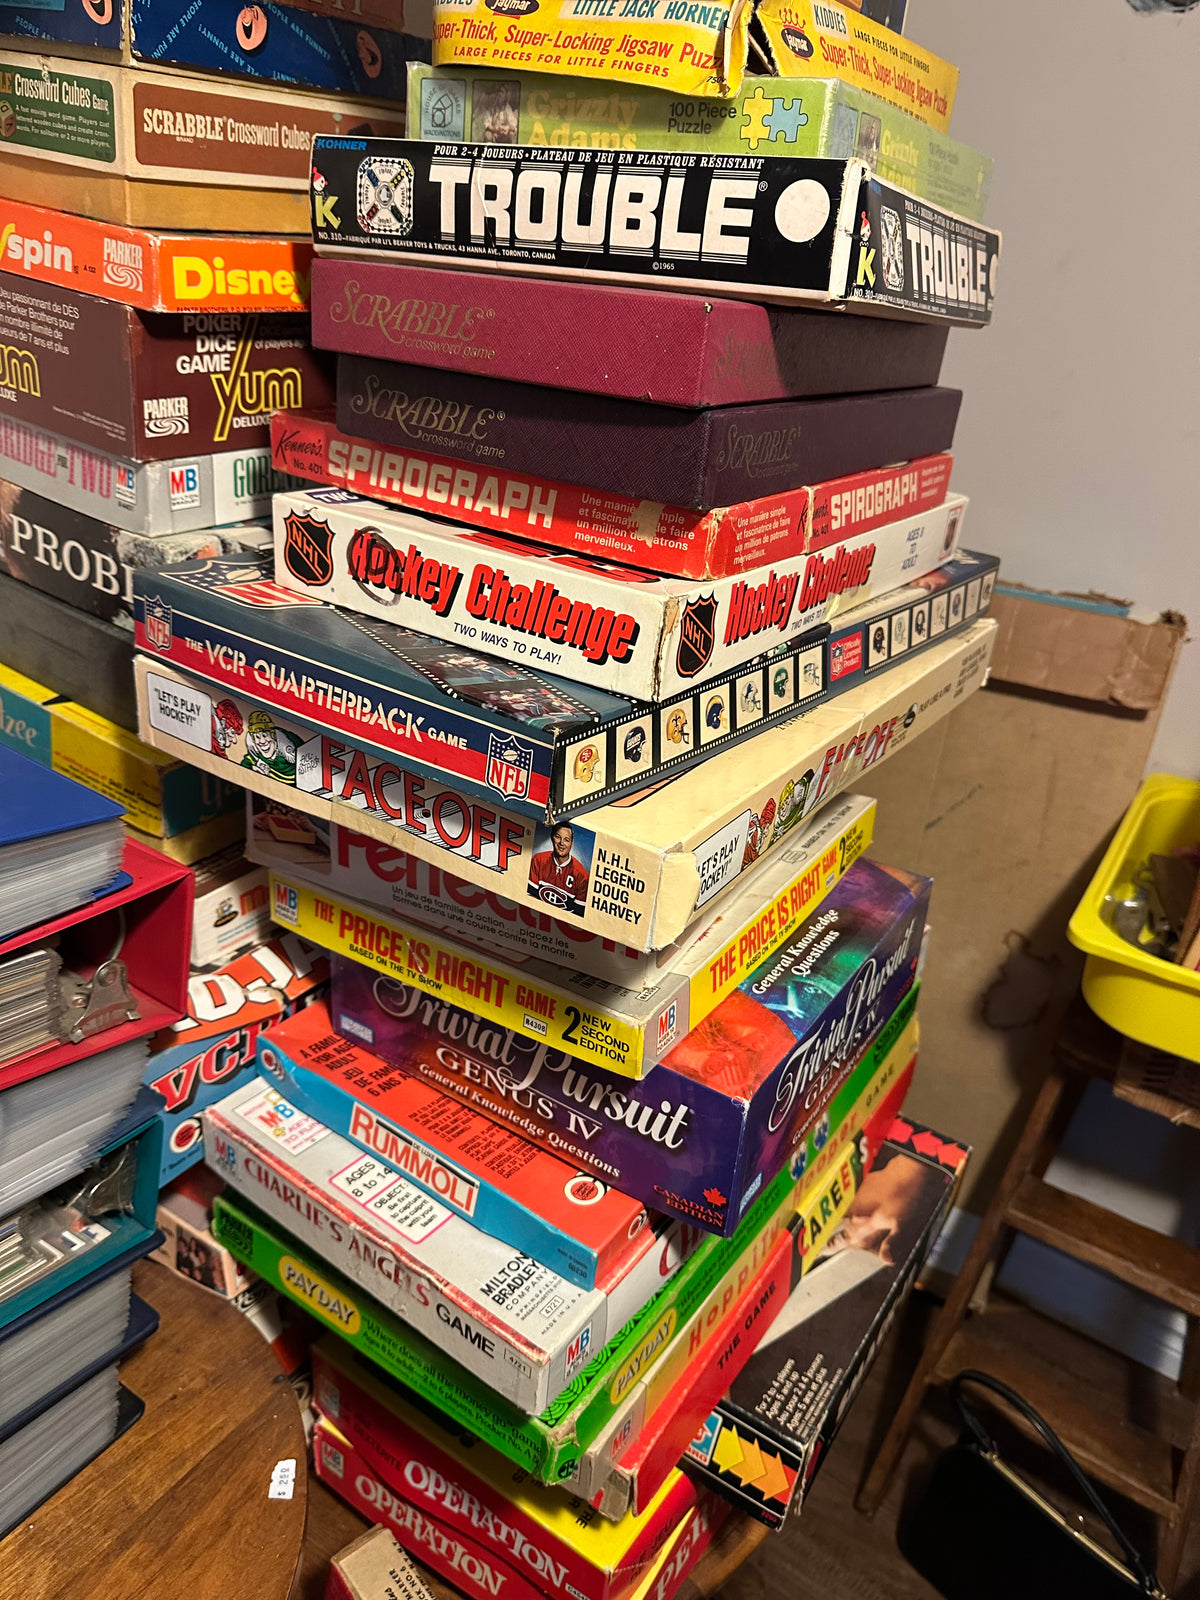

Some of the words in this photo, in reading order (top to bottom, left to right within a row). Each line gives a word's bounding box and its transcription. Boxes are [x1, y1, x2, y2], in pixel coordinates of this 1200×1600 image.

[620, 0, 657, 18] JACK
[666, 1, 729, 31] HORNER
[814, 5, 848, 35] KIDDIES
[504, 25, 614, 57] Super-Locking
[616, 34, 674, 59] Jigsaw
[453, 46, 487, 58] LARGE
[492, 49, 532, 62] PIECES
[567, 56, 604, 69] LITTLE
[611, 59, 670, 78] FINGERS
[819, 36, 873, 80] Super-Thick,
[873, 56, 916, 98] Super-Locking
[916, 80, 933, 108] Jigsaw
[14, 73, 60, 103] Crossword
[62, 80, 91, 109] Cubes
[527, 90, 640, 128] Grizzly
[669, 102, 695, 118] 100
[700, 103, 737, 119] Piece
[143, 107, 224, 141] SCRABBLE
[227, 117, 279, 148] Crossword
[281, 124, 311, 151] Cubes
[527, 121, 637, 150] Adams
[668, 118, 711, 134] Puzzle
[316, 138, 368, 151] KOHNER
[433, 145, 458, 156] POUR
[460, 146, 478, 157] 2-4
[481, 146, 523, 160] JOUEURS
[530, 150, 575, 162] PLATEAU
[595, 152, 614, 164] JEU
[637, 154, 696, 167] PLASTIQUE
[700, 155, 765, 170] RÉSISTANT
[429, 163, 759, 258] TROUBLE
[104, 237, 143, 270] PARKER
[466, 246, 487, 255] HANNA
[502, 250, 530, 260] TORONTO,
[532, 251, 556, 260] CANADA
[906, 221, 988, 307] TROUBLE
[11, 292, 51, 311] passionnant
[28, 306, 58, 325] Brothers
[183, 315, 242, 333] POKER
[196, 335, 237, 353] DICE
[405, 335, 460, 356] crossword
[462, 344, 495, 361] game
[176, 354, 231, 374] GAME
[144, 397, 188, 420] PARKER
[232, 415, 271, 429] DELUXE
[421, 432, 475, 452] crossword
[476, 443, 505, 459] game
[67, 442, 112, 499] TWO
[170, 467, 198, 497] MB
[308, 463, 323, 476] 401
[328, 440, 558, 529] SPIROGRAPH
[581, 492, 601, 507] Une
[831, 471, 919, 530] SPIROGRAPH
[576, 519, 589, 529] un
[592, 521, 627, 537] million
[670, 526, 695, 540] faire
[737, 516, 749, 528] Une
[292, 523, 324, 577] NHL
[574, 531, 636, 553] merveilleux.
[348, 529, 462, 613] Hockey
[465, 563, 639, 664] Challenge
[723, 570, 798, 646] Hockey
[798, 543, 876, 614] Challenge
[147, 616, 170, 646] NFL
[453, 622, 478, 638] TWO
[480, 631, 509, 650] WAYS
[512, 640, 527, 654] TO
[530, 645, 562, 665] PLAY!
[684, 621, 710, 656] NHL
[180, 698, 201, 717] PLAY
[184, 636, 204, 654] THE
[204, 639, 246, 678] VCR
[252, 659, 426, 744] QUARTERBACK
[427, 727, 468, 751] GAME
[489, 758, 526, 794] NFL
[596, 847, 636, 875] N.H.L.
[719, 834, 741, 861] PLAY
[592, 880, 630, 905] DOUG
[594, 864, 646, 894] LEGEND
[275, 882, 298, 910] MB
[591, 895, 643, 926] HARVEY
[474, 912, 505, 930] action
[709, 946, 737, 994] THE
[737, 909, 777, 969] PRICE
[790, 867, 823, 918] RIGHT
[314, 898, 335, 925] THE
[340, 907, 404, 964] PRICE
[406, 937, 432, 976] IS
[434, 948, 510, 1010] RIGHT
[515, 983, 557, 1022] GAME
[349, 943, 375, 962] BASED
[389, 961, 405, 975] THE
[541, 943, 577, 961] montre.
[751, 952, 795, 995] General
[789, 907, 840, 957] Knowledge
[790, 929, 840, 978] Questions
[561, 1004, 582, 1046] 2
[582, 1012, 612, 1032] NEW
[658, 1003, 677, 1039] MB
[579, 1038, 626, 1065] EDITION
[580, 1025, 630, 1054] SECOND
[325, 1053, 360, 1072] ADULT
[341, 1067, 364, 1080] JEU
[436, 1046, 555, 1120] GENUS
[567, 1110, 603, 1141] IV
[498, 1030, 696, 1150] Pursuit
[418, 1062, 468, 1101] General
[470, 1087, 547, 1139] Knowledge
[548, 1130, 622, 1180] Questions
[344, 1160, 377, 1187] AGES
[350, 1103, 477, 1213] RUMMOLI
[352, 1188, 364, 1199] 8
[373, 1181, 410, 1210] OBJECT:
[399, 1193, 423, 1216] capture
[653, 1183, 724, 1221] CANADIAN
[665, 1197, 724, 1229] EDITION
[243, 1156, 344, 1244] CHARLIE'S
[348, 1233, 431, 1308] ANGELS
[435, 1301, 497, 1360] GAME
[480, 1250, 530, 1297] MILTON
[285, 1263, 357, 1326] PAYDAY
[491, 1259, 542, 1307] BRADLEY
[505, 1267, 550, 1312] COMPANY
[515, 1274, 559, 1318] SPRINGFIELD
[716, 1332, 742, 1370] THE
[743, 1279, 778, 1331] GAME
[566, 1327, 591, 1365] MB
[615, 1309, 674, 1396] PAYDAY
[776, 1357, 796, 1383] players
[785, 1393, 800, 1415] pour
[805, 1352, 824, 1380] joueurs
[454, 1382, 493, 1418] money
[765, 1403, 781, 1420] Ages
[354, 1474, 508, 1597] OPERATION
[403, 1459, 571, 1590] OPÉRATION
